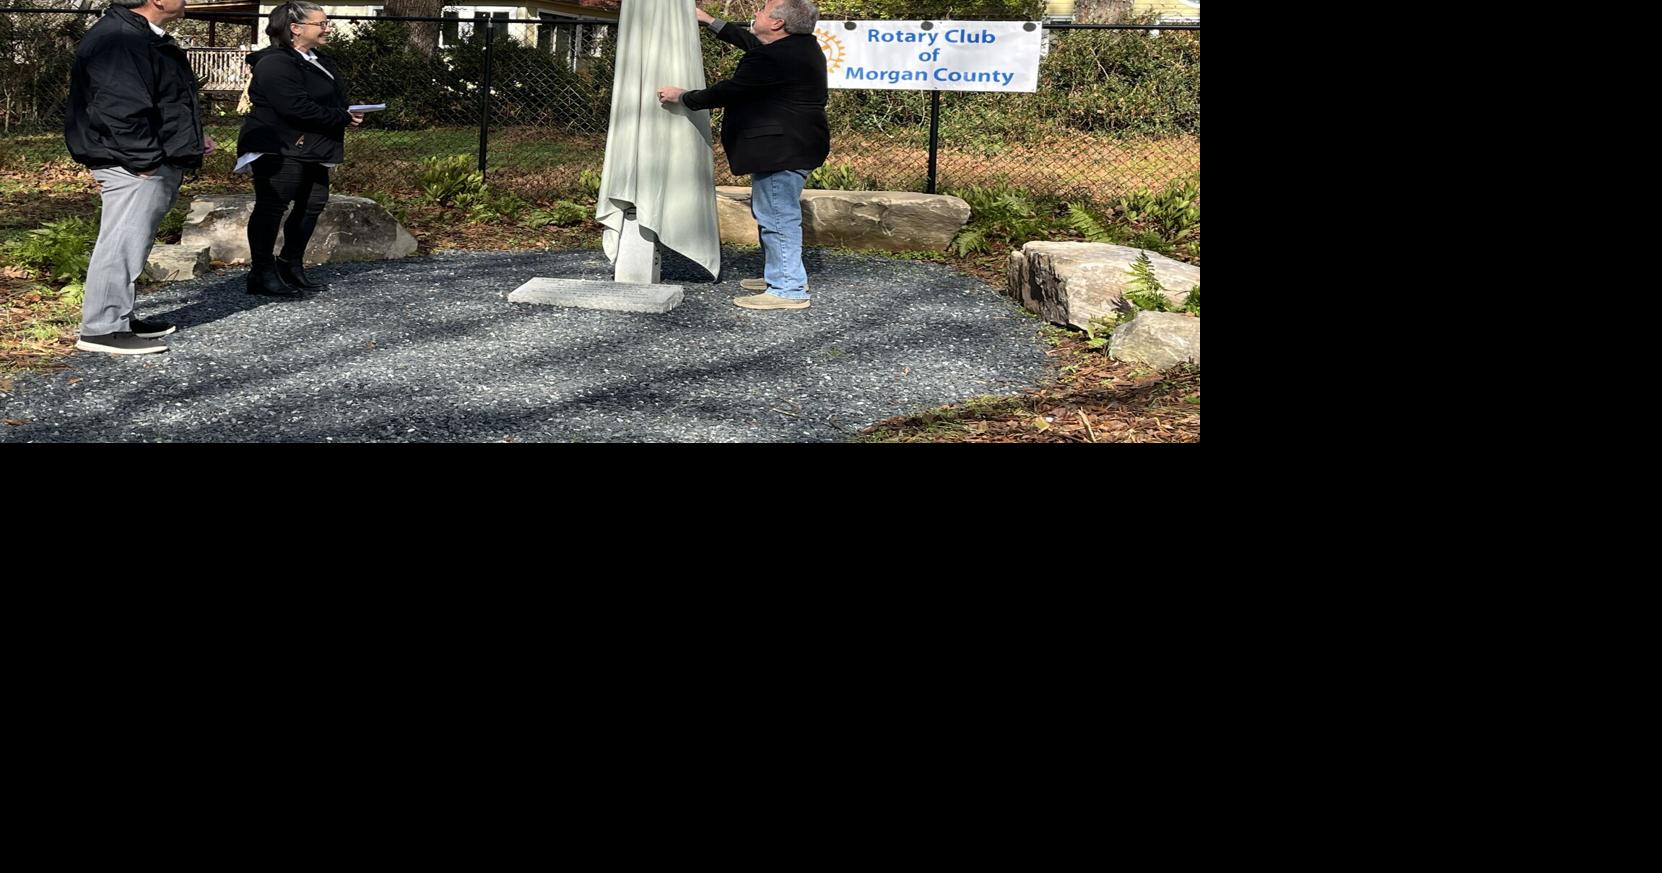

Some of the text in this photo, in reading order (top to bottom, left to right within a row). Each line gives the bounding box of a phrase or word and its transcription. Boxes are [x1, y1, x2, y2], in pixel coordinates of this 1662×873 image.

[867, 28, 997, 46] Rotary Club
[918, 47, 940, 62] of
[845, 66, 1014, 86] Morgan County
